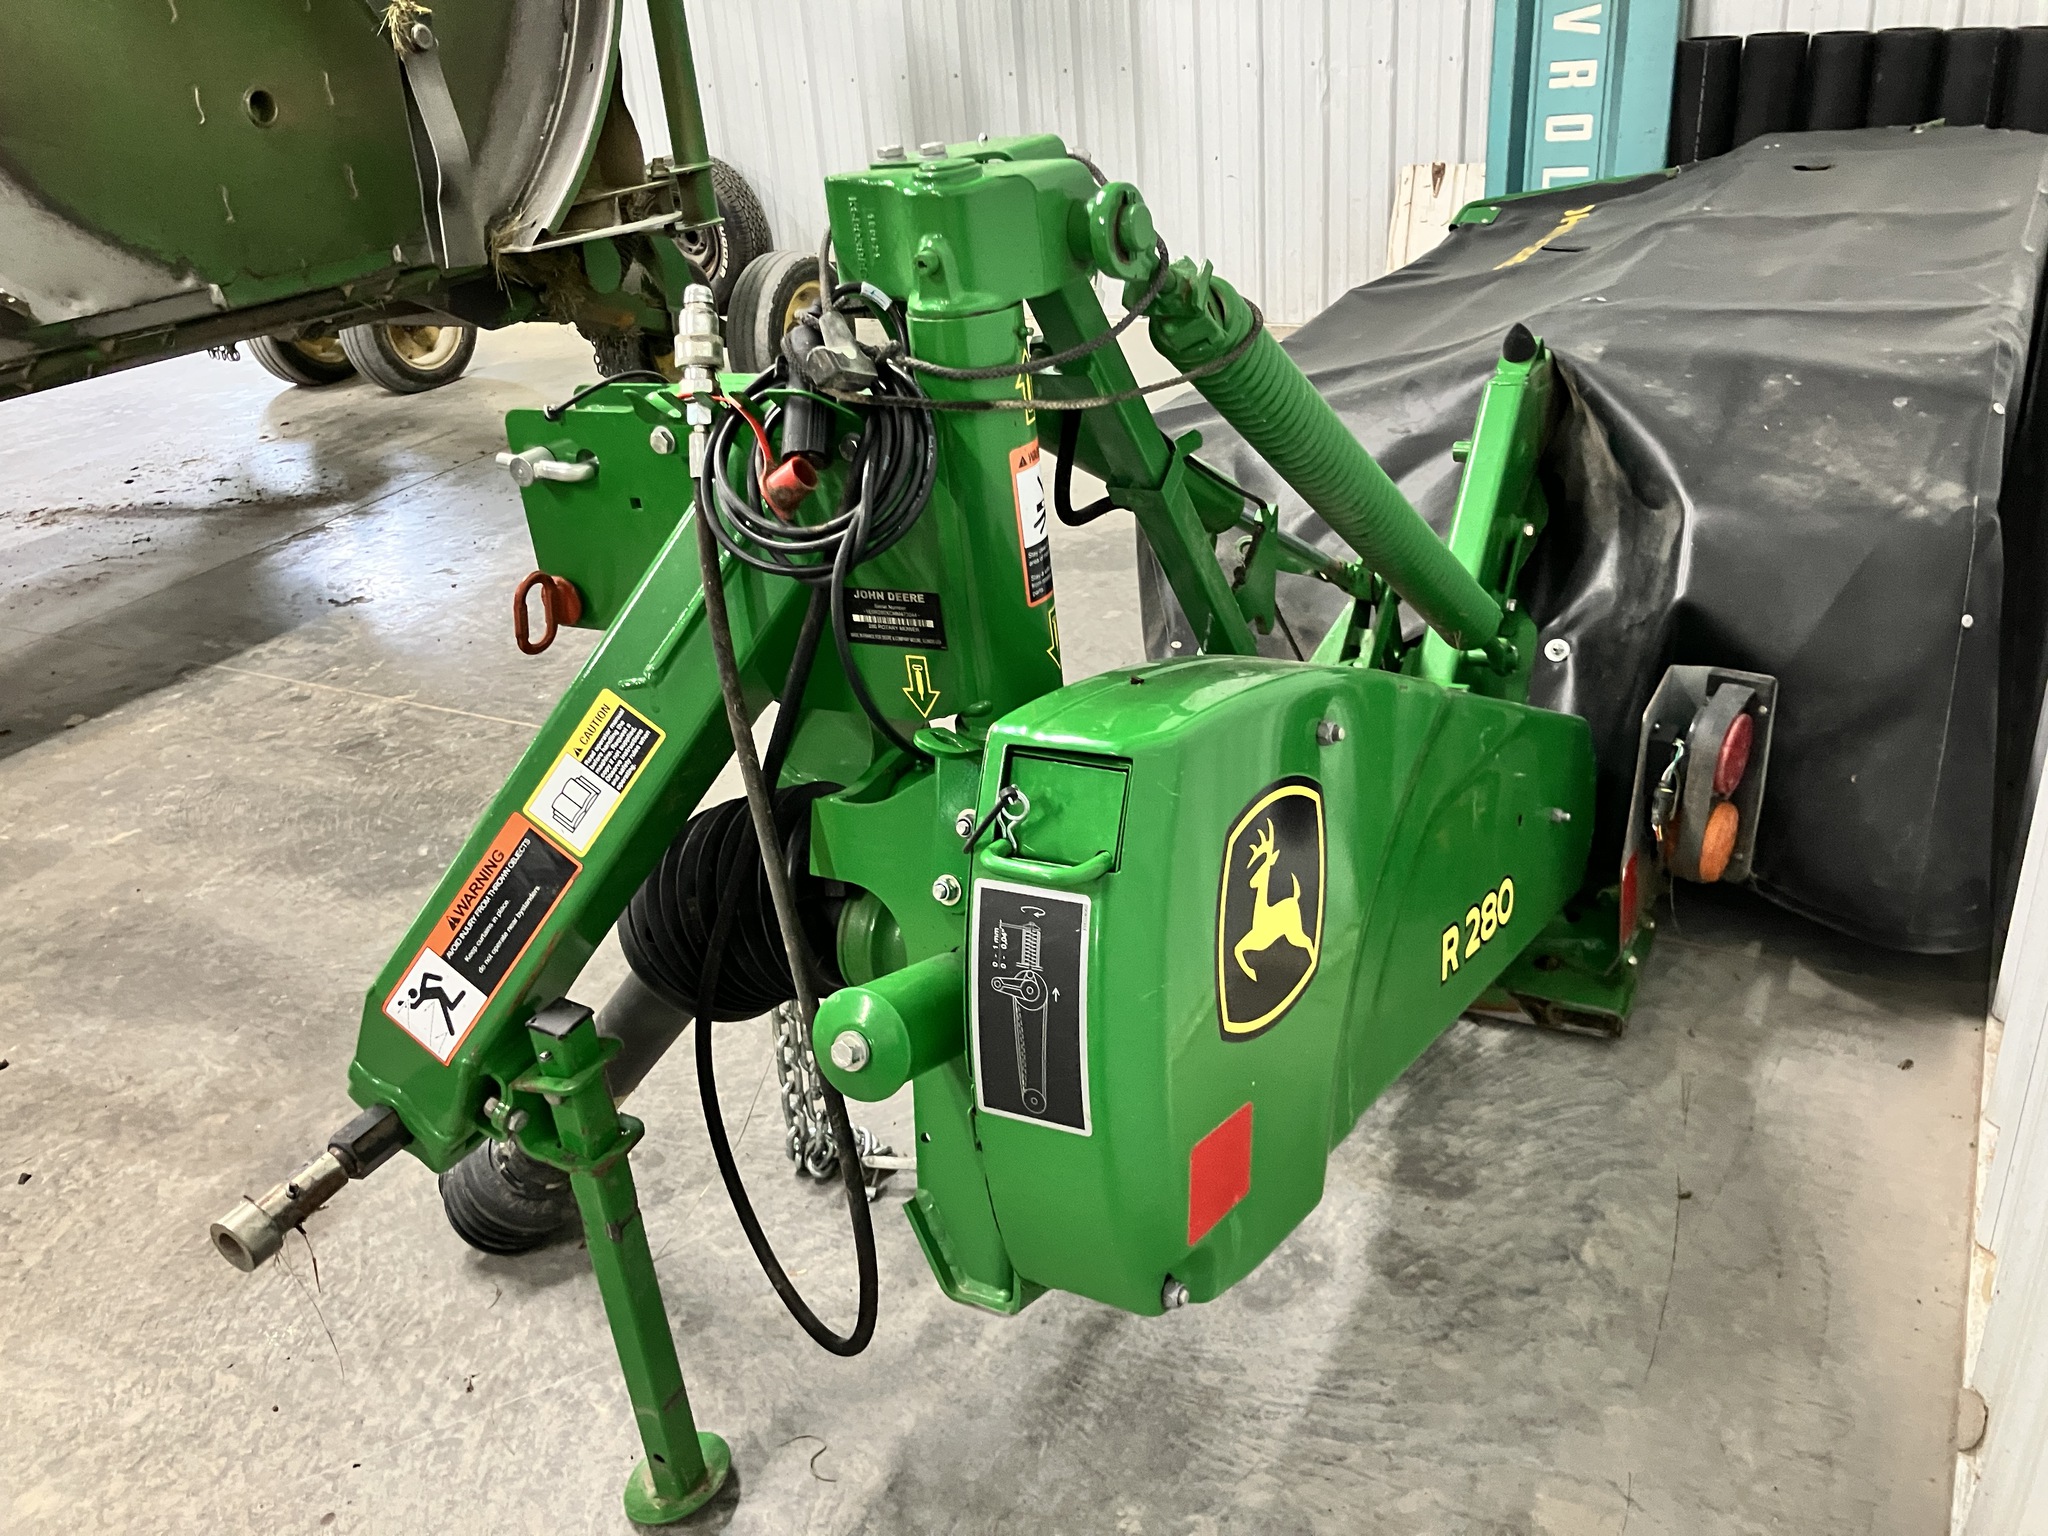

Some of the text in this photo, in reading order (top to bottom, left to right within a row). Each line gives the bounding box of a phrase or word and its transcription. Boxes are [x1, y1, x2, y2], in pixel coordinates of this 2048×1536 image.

[853, 589, 925, 603] JOHN DEERE
[579, 703, 610, 745] CAUTION
[583, 749, 596, 766] Read
[609, 707, 625, 730] manual
[588, 719, 625, 770] before handling the
[594, 750, 614, 774] machine.
[610, 726, 629, 751] Request
[600, 763, 612, 778] copy
[612, 749, 622, 761] not
[618, 726, 637, 751] supplied.
[604, 728, 644, 782] Observe instructions
[610, 729, 651, 787] and safety rules when
[616, 763, 637, 791] operating.
[446, 837, 531, 960] AVOID INJURY FROM THROWN OBJECTS
[452, 849, 504, 917] WARNING
[463, 945, 478, 962] Keep
[475, 922, 494, 946] curtains
[496, 899, 509, 918] place.
[478, 964, 486, 974] do
[483, 953, 493, 965] not
[491, 931, 509, 955] operate
[506, 917, 518, 933] near
[993, 926, 1000, 944] mm
[1441, 876, 1514, 985] R 280
